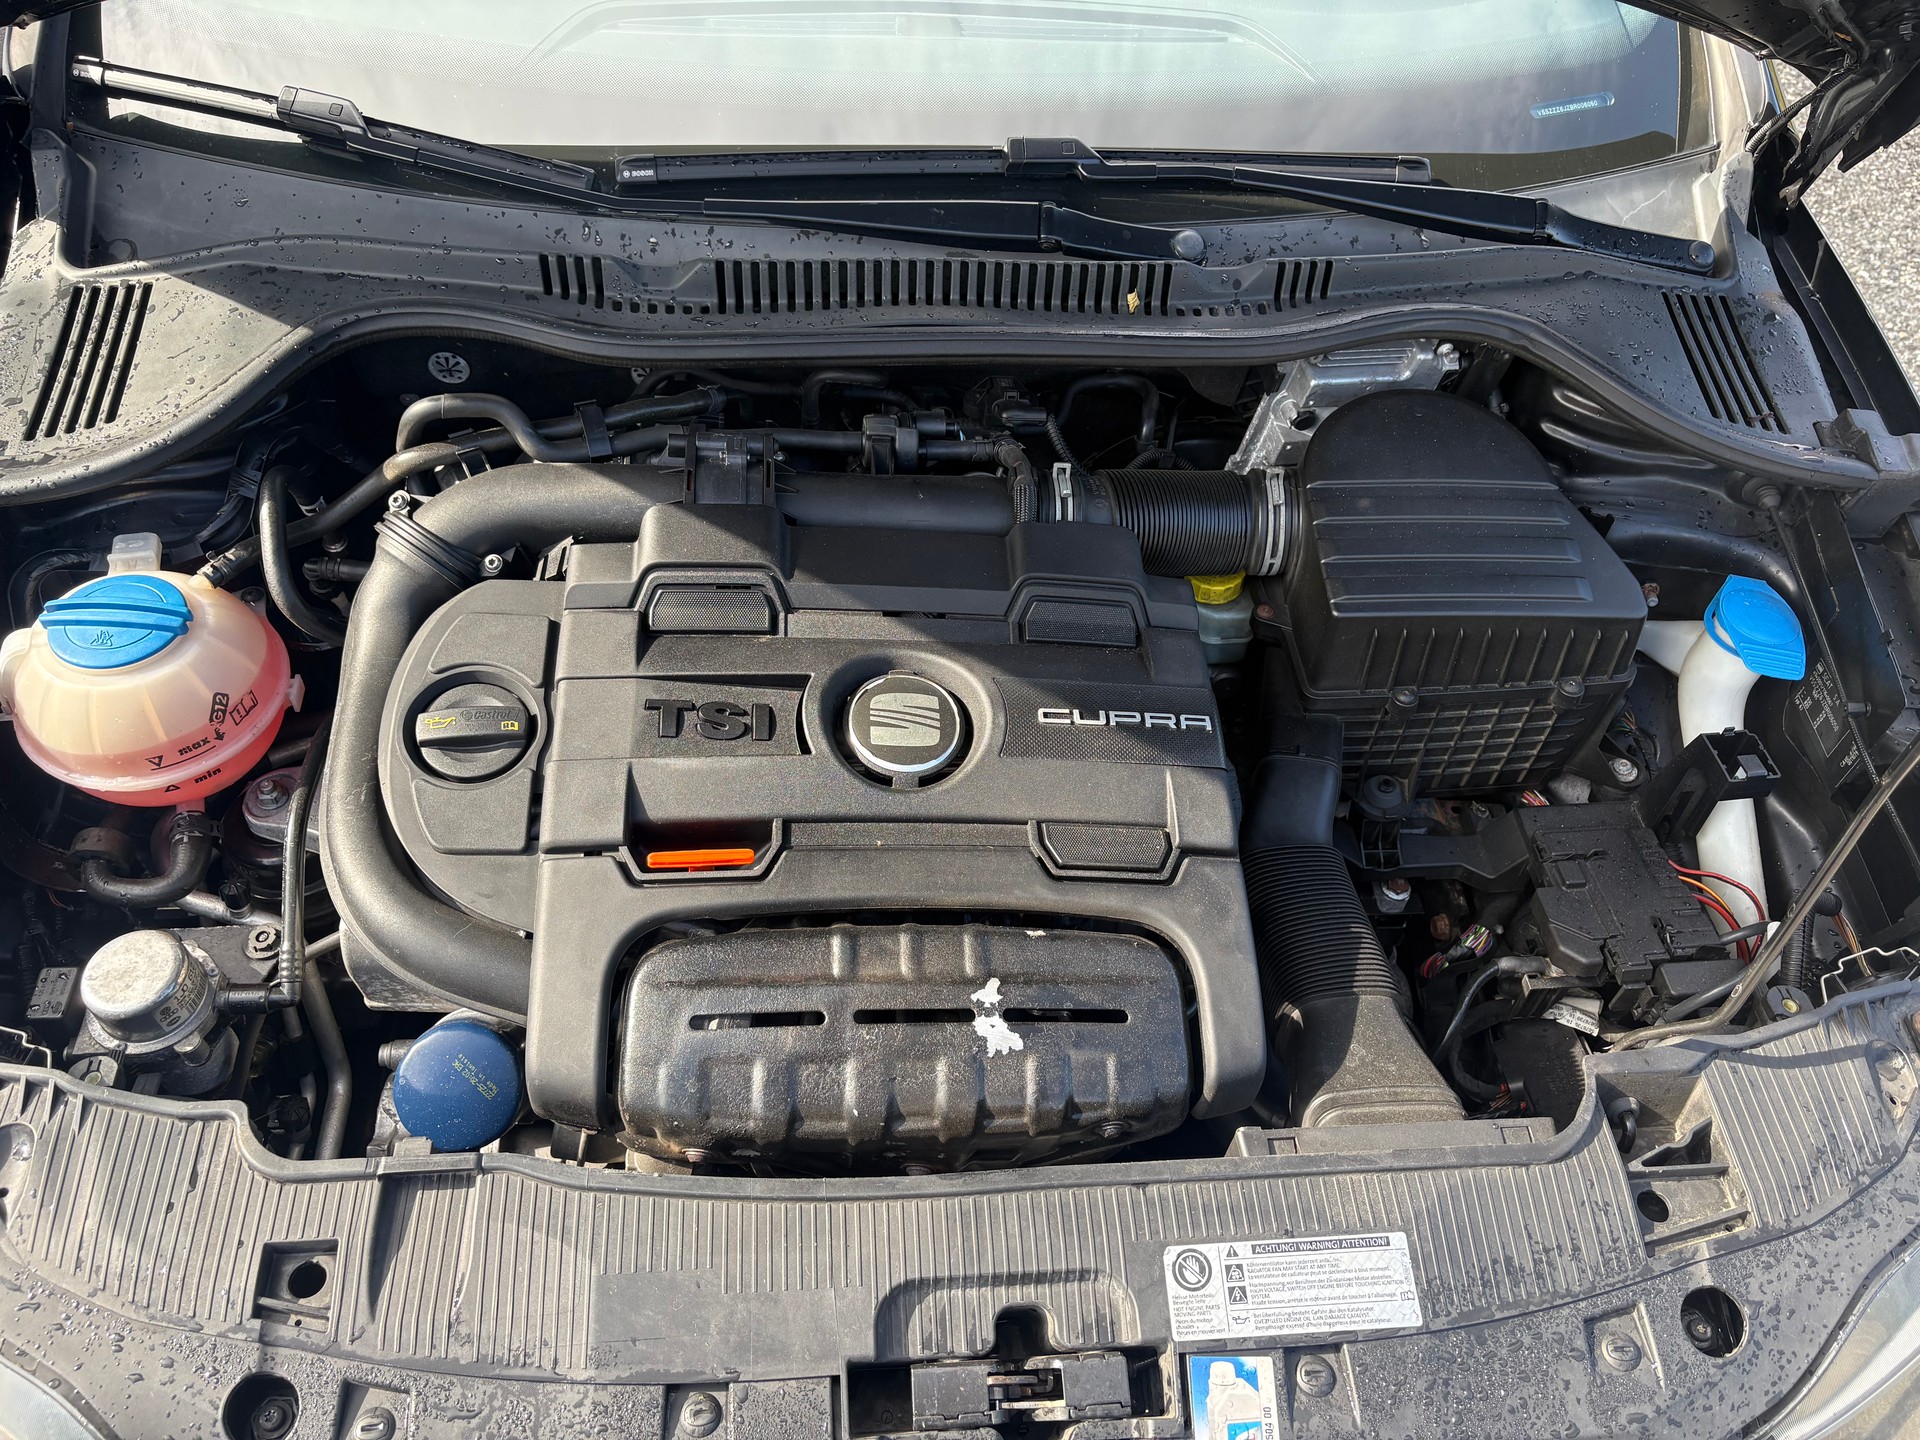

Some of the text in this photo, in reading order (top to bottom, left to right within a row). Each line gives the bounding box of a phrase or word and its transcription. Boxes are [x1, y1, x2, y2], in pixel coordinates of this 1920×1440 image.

[1822, 672, 1834, 689] SEAT
[212, 694, 228, 722] G12
[473, 709, 511, 720] Castrol
[644, 699, 774, 742] TSI
[1038, 708, 1213, 731] CUPRA
[178, 737, 211, 756] max
[194, 768, 222, 784] min
[1254, 1237, 1387, 1253] ACHTUNG! WARNING! ATTENTION!
[1262, 1406, 1274, 1440] 504 00
